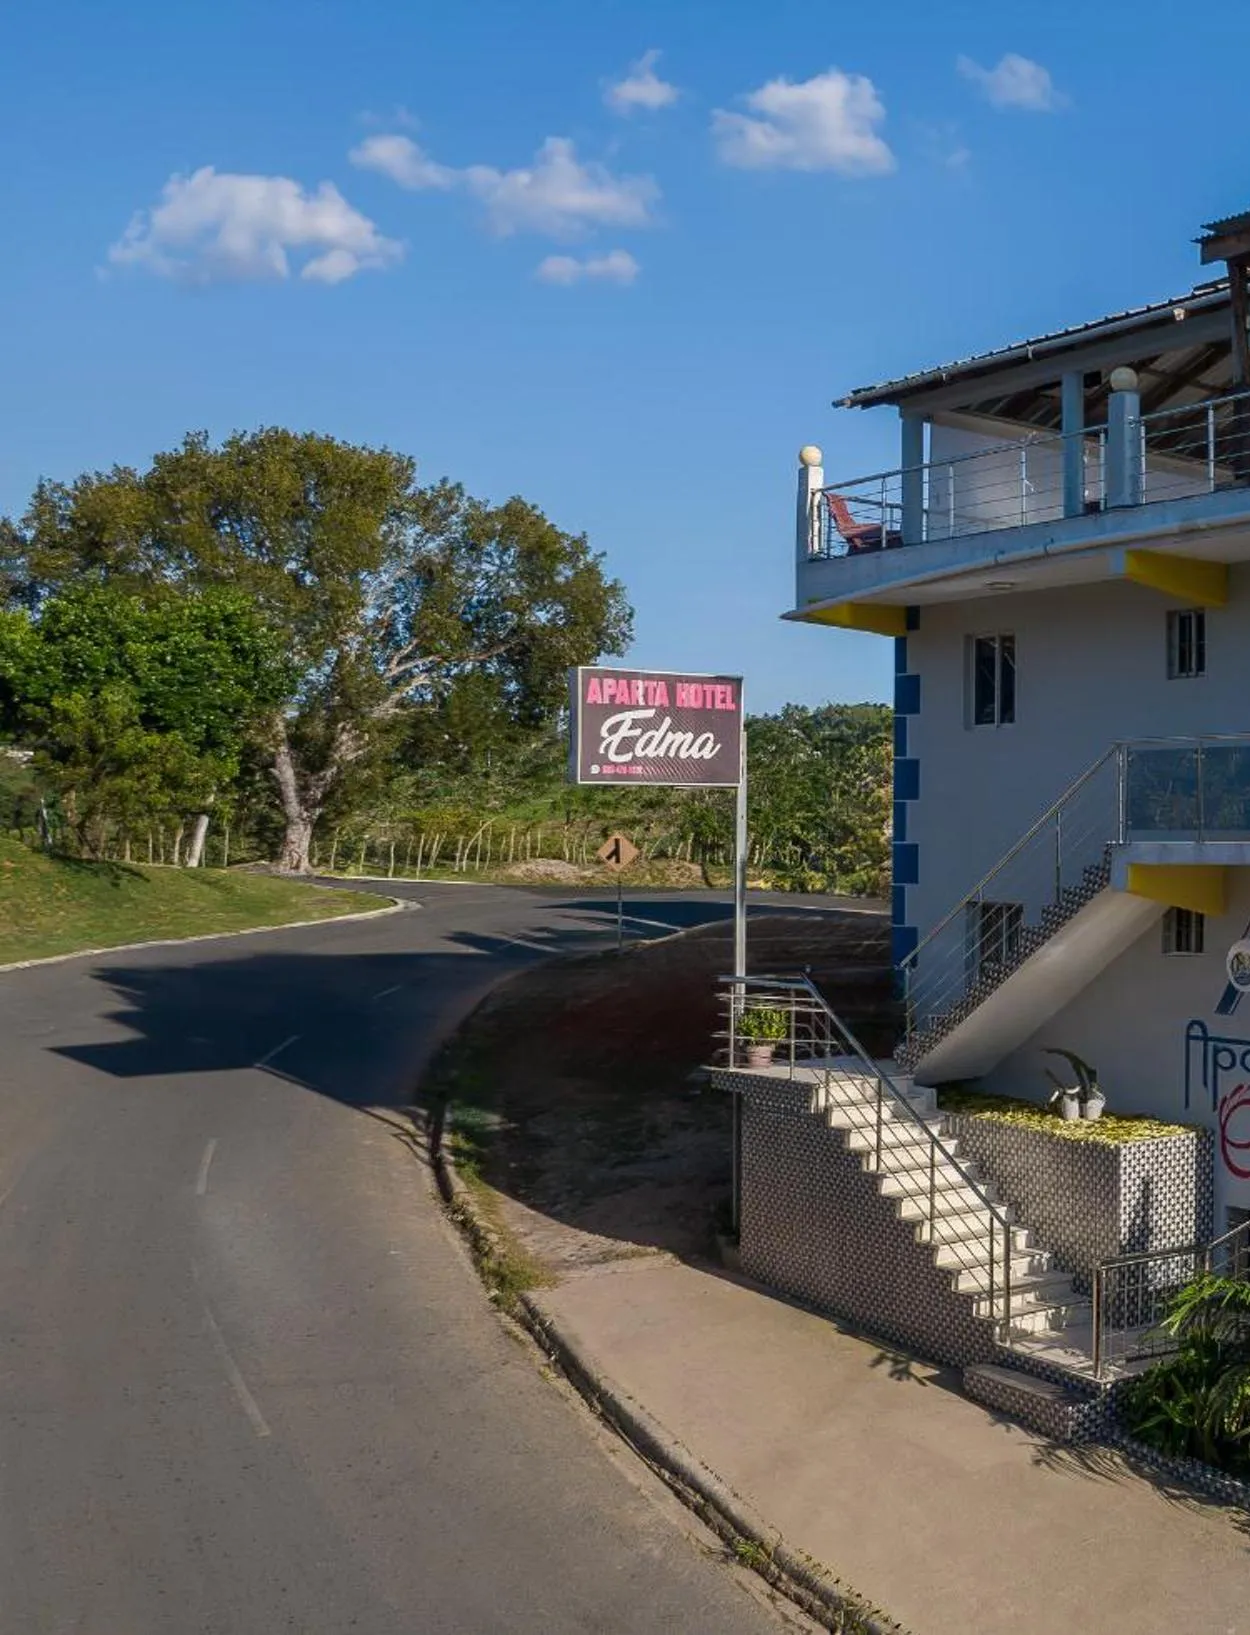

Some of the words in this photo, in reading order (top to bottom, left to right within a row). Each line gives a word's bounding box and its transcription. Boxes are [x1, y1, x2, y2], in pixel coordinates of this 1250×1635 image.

[586, 677, 669, 707] APARTA
[676, 682, 736, 711] HOTEL
[599, 708, 722, 763] Edma
